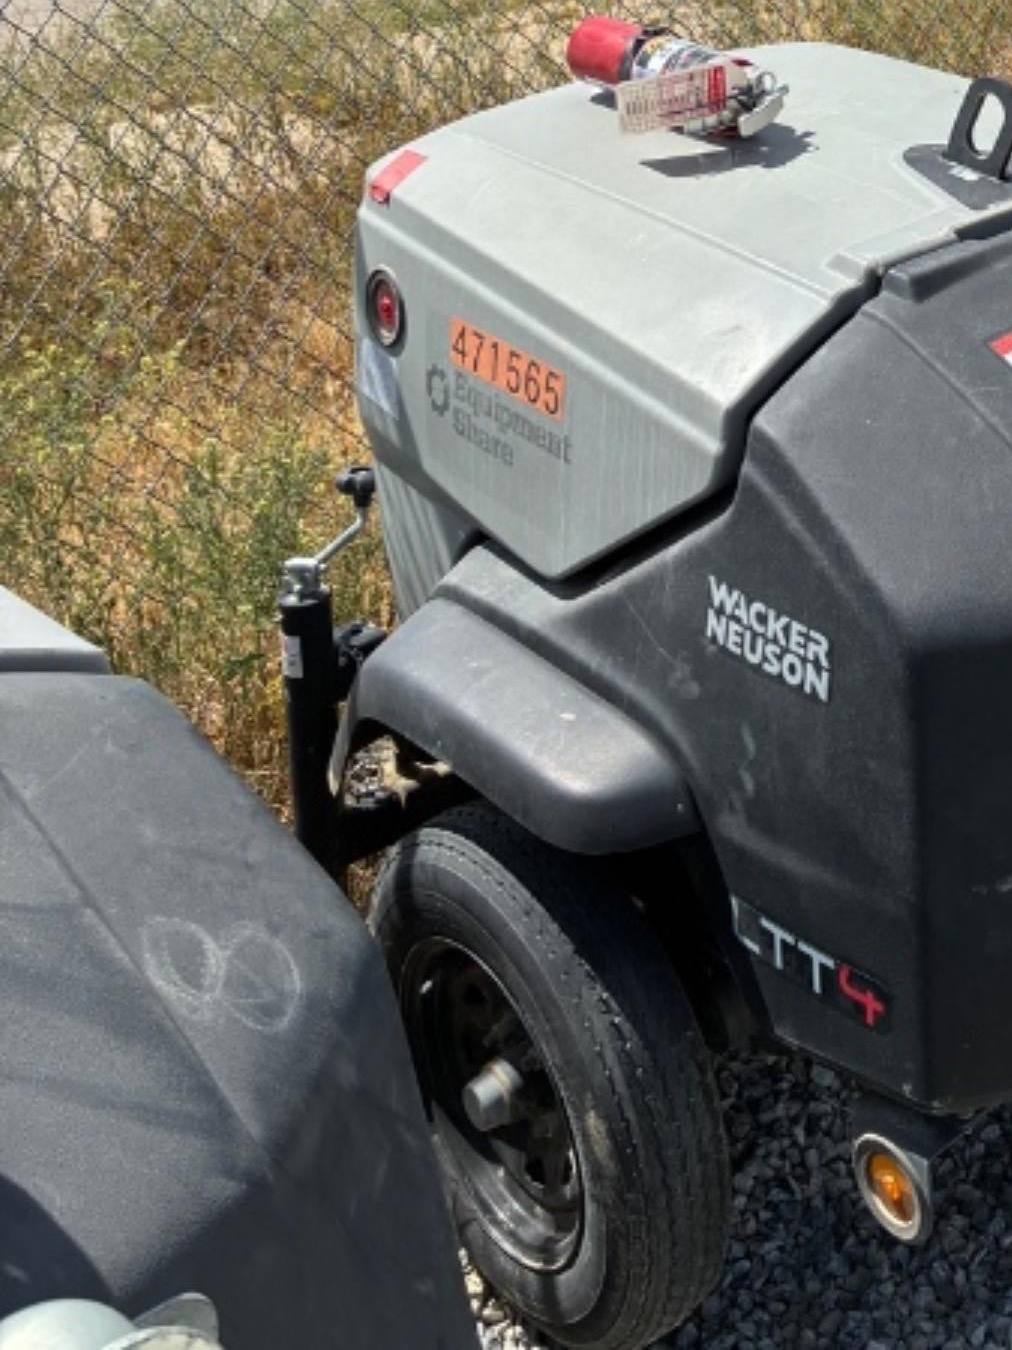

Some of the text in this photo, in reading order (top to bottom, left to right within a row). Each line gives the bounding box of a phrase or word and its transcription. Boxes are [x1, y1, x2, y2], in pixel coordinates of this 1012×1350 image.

[451, 325, 561, 415] 471565
[452, 406, 514, 466] Share
[453, 372, 572, 465] Equipment
[706, 608, 830, 703] NEUSON
[708, 575, 831, 669] WACKER
[731, 895, 887, 1028] LTT4
